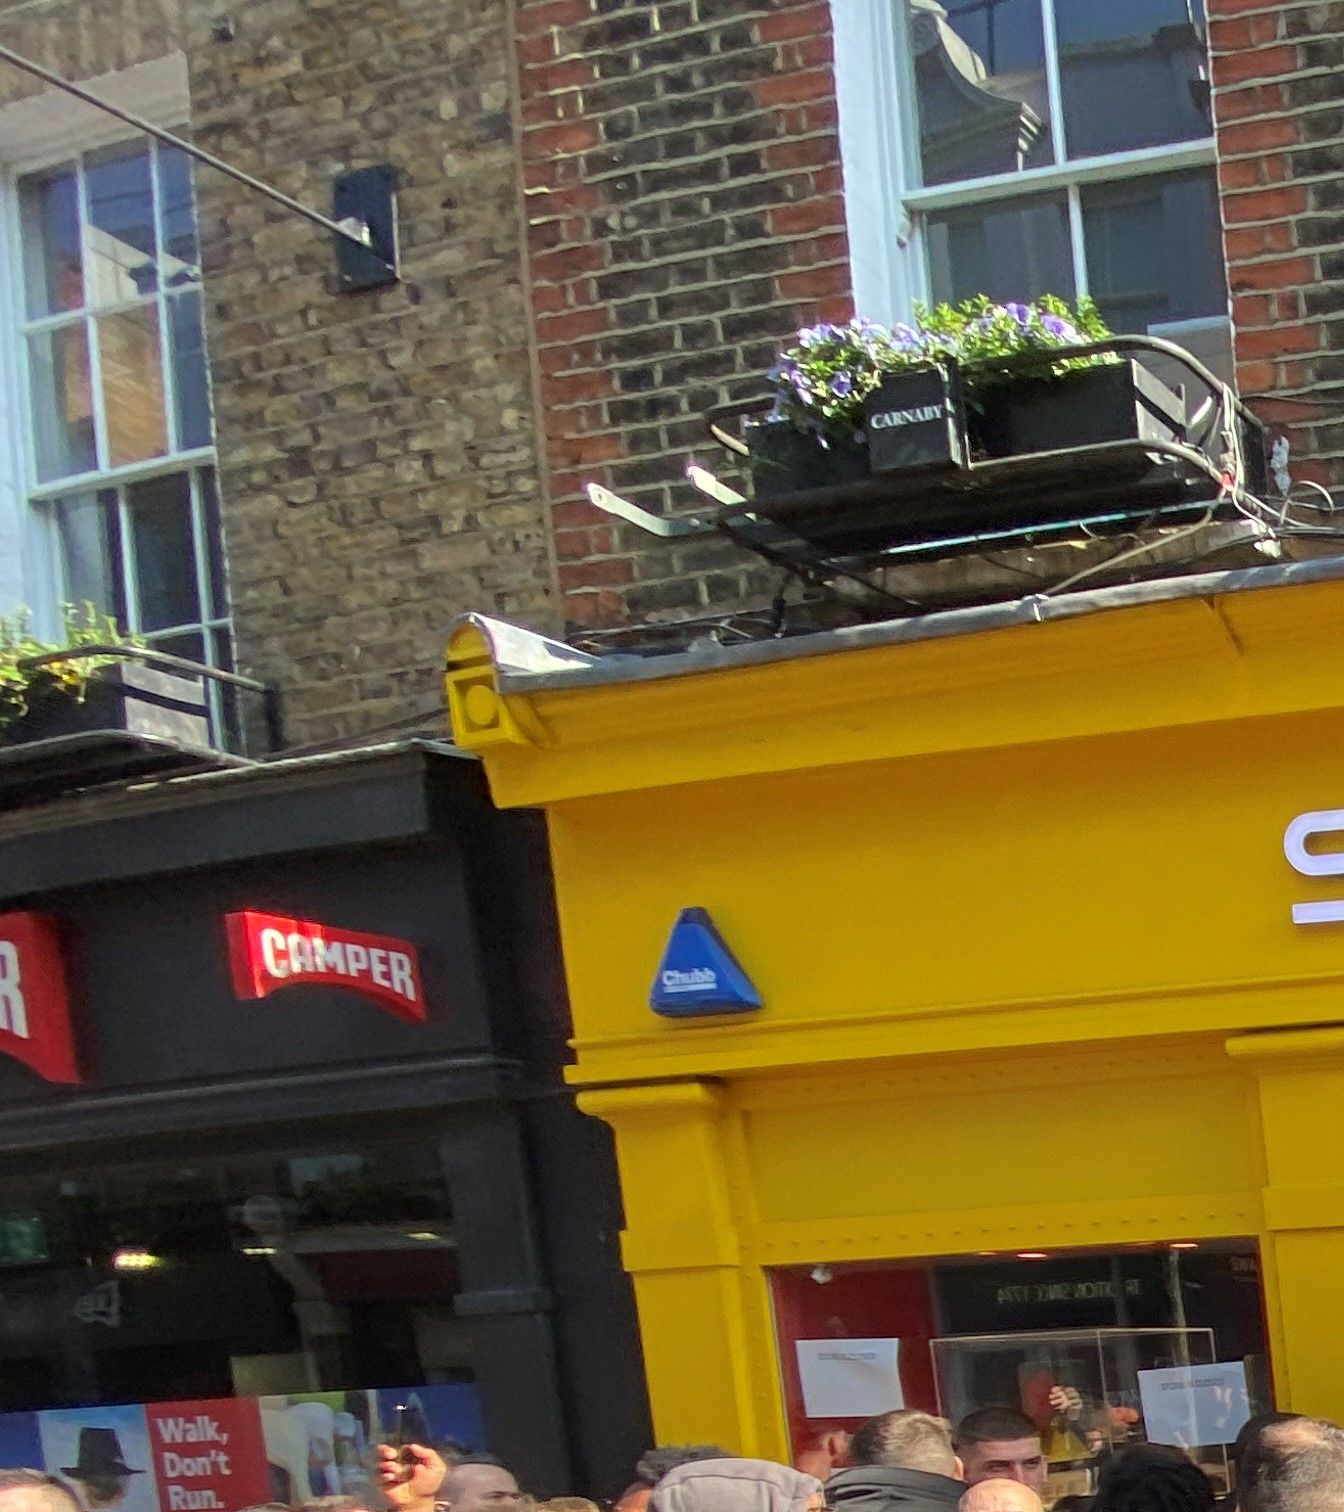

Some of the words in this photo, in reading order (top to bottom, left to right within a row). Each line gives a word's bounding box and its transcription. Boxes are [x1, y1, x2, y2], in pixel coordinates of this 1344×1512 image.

[870, 404, 943, 429] CARNABY
[261, 927, 417, 1003] CAMPER
[157, 1415, 230, 1446] Walk,
[162, 1449, 232, 1478] Don't
[167, 1485, 226, 1511] Run.
